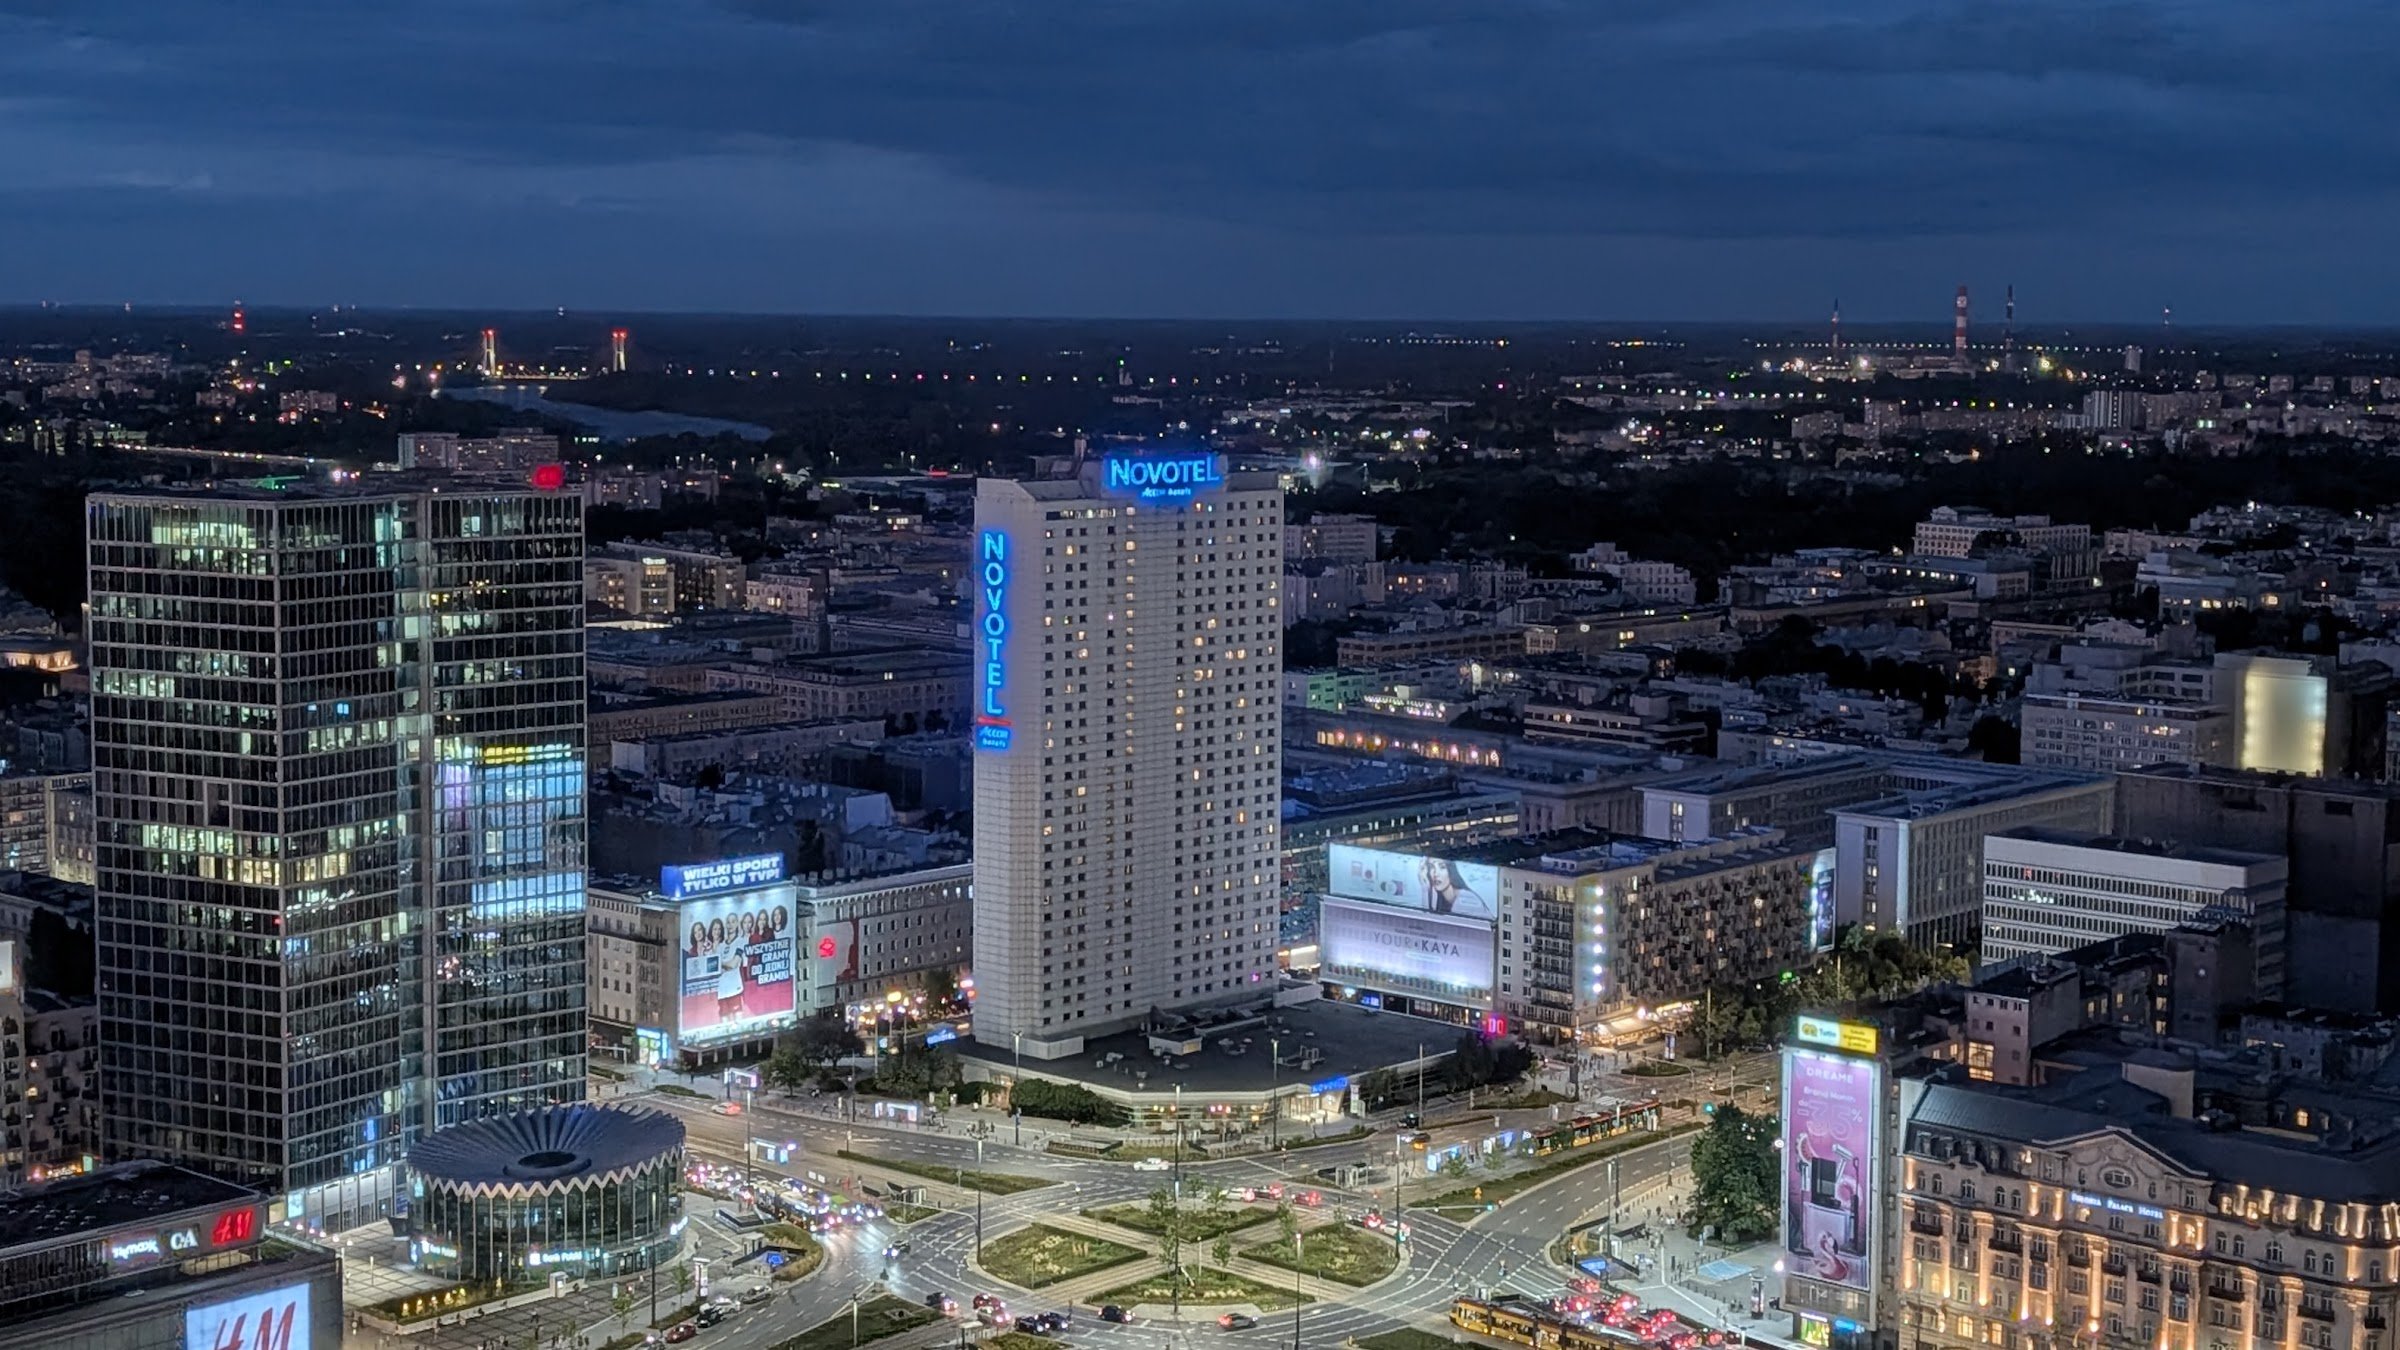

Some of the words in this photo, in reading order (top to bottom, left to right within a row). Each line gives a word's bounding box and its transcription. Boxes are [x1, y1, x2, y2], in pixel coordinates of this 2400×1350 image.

[1110, 456, 1220, 486] NOVOTEL
[985, 533, 1005, 715] NOVOTEL
[683, 864, 731, 881] WIELKI
[733, 857, 780, 875] SPORT
[683, 875, 730, 893] TYLKO
[732, 873, 746, 885] W
[749, 867, 781, 882] TVP!
[745, 940, 790, 956] WSZYSTKIE
[1373, 931, 1412, 949] YOUR
[1421, 939, 1460, 957] KAYA
[762, 950, 790, 964] GRAMY
[758, 970, 790, 985] BRAMKI
[1806, 1066, 1855, 1085] DREAME
